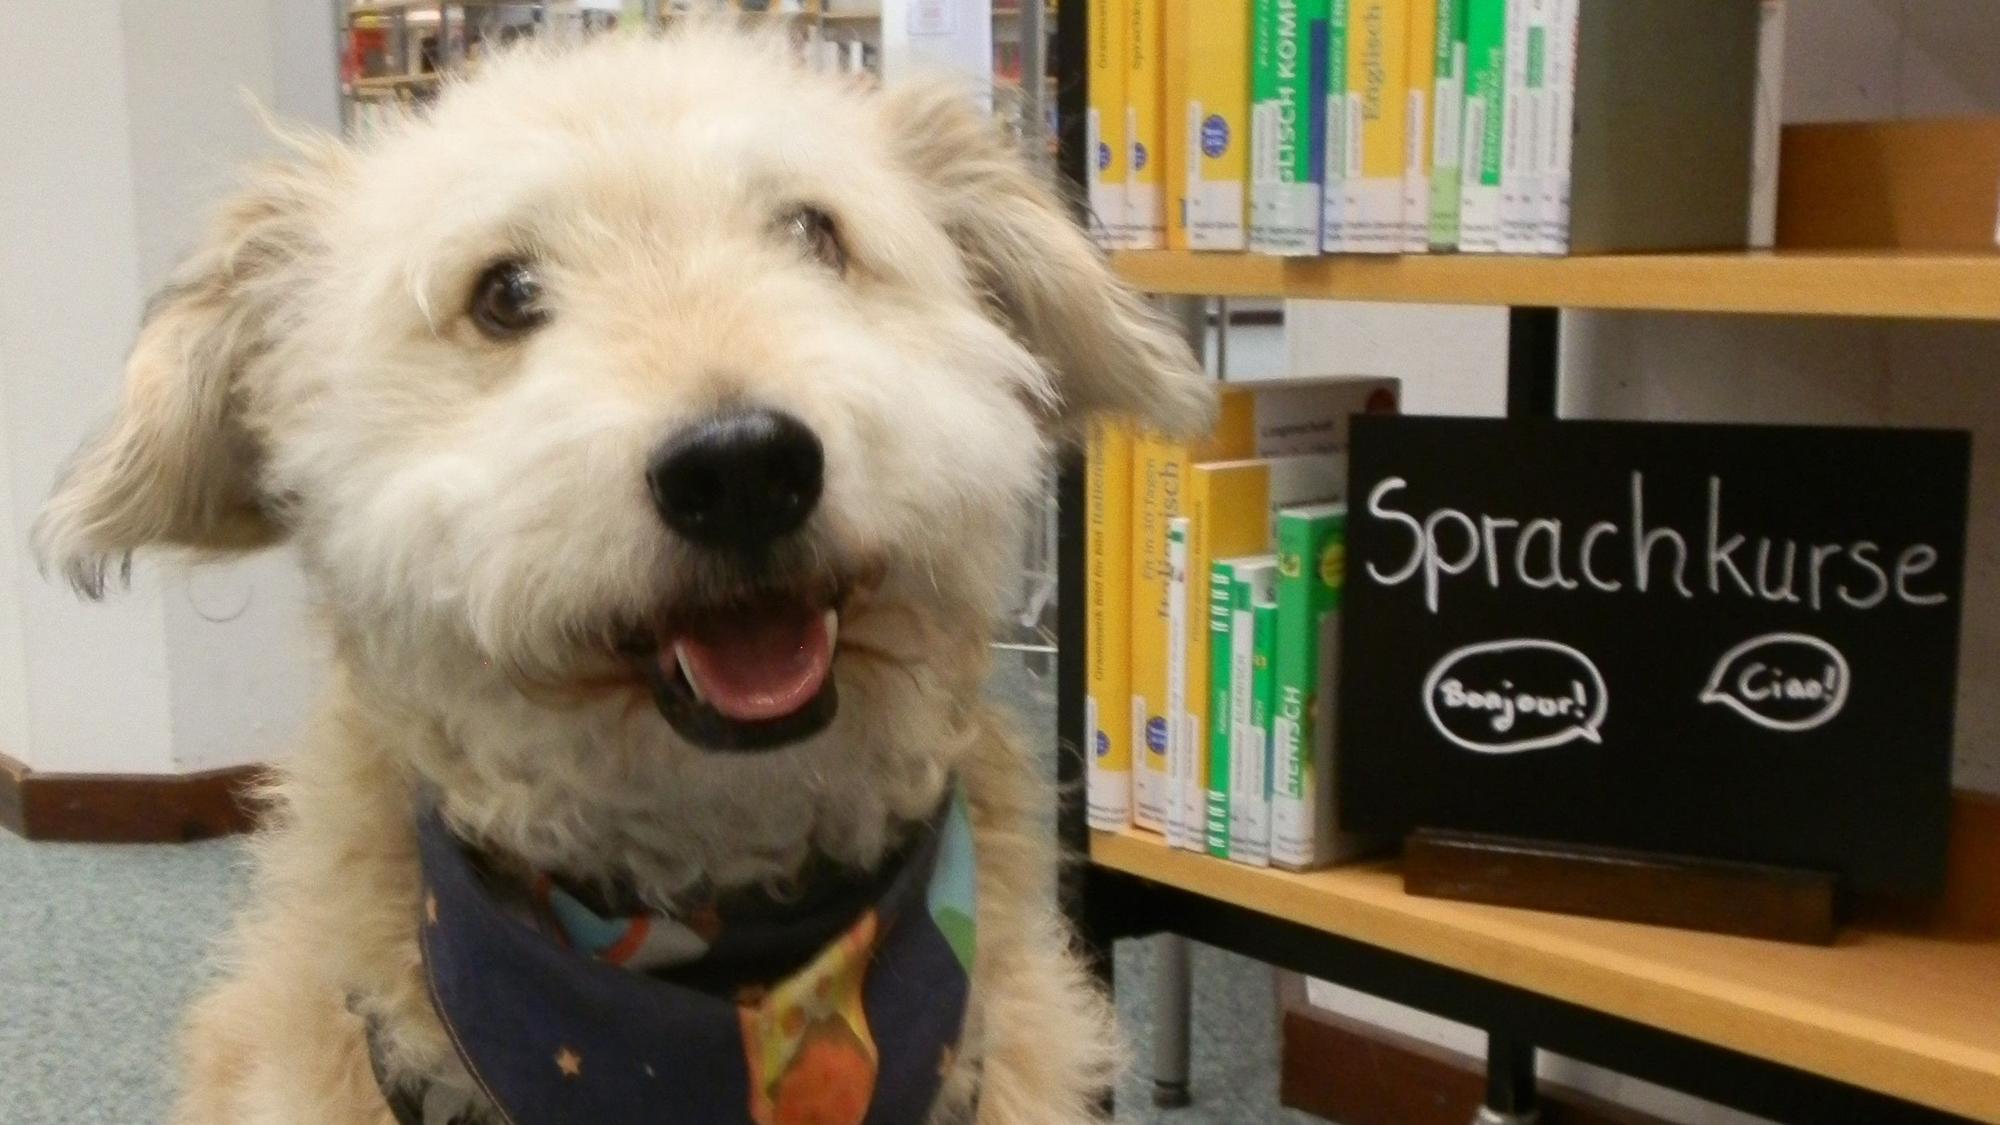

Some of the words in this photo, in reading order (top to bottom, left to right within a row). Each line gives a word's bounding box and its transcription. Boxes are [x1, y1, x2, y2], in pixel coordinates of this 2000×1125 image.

[1277, 87, 1297, 226] GLISCH
[1156, 461, 1179, 622] Itliisch
[1366, 471, 1946, 613] Sprachkurse
[1439, 680, 1587, 731] Bonjour!
[1737, 664, 1834, 701] Ciao!
